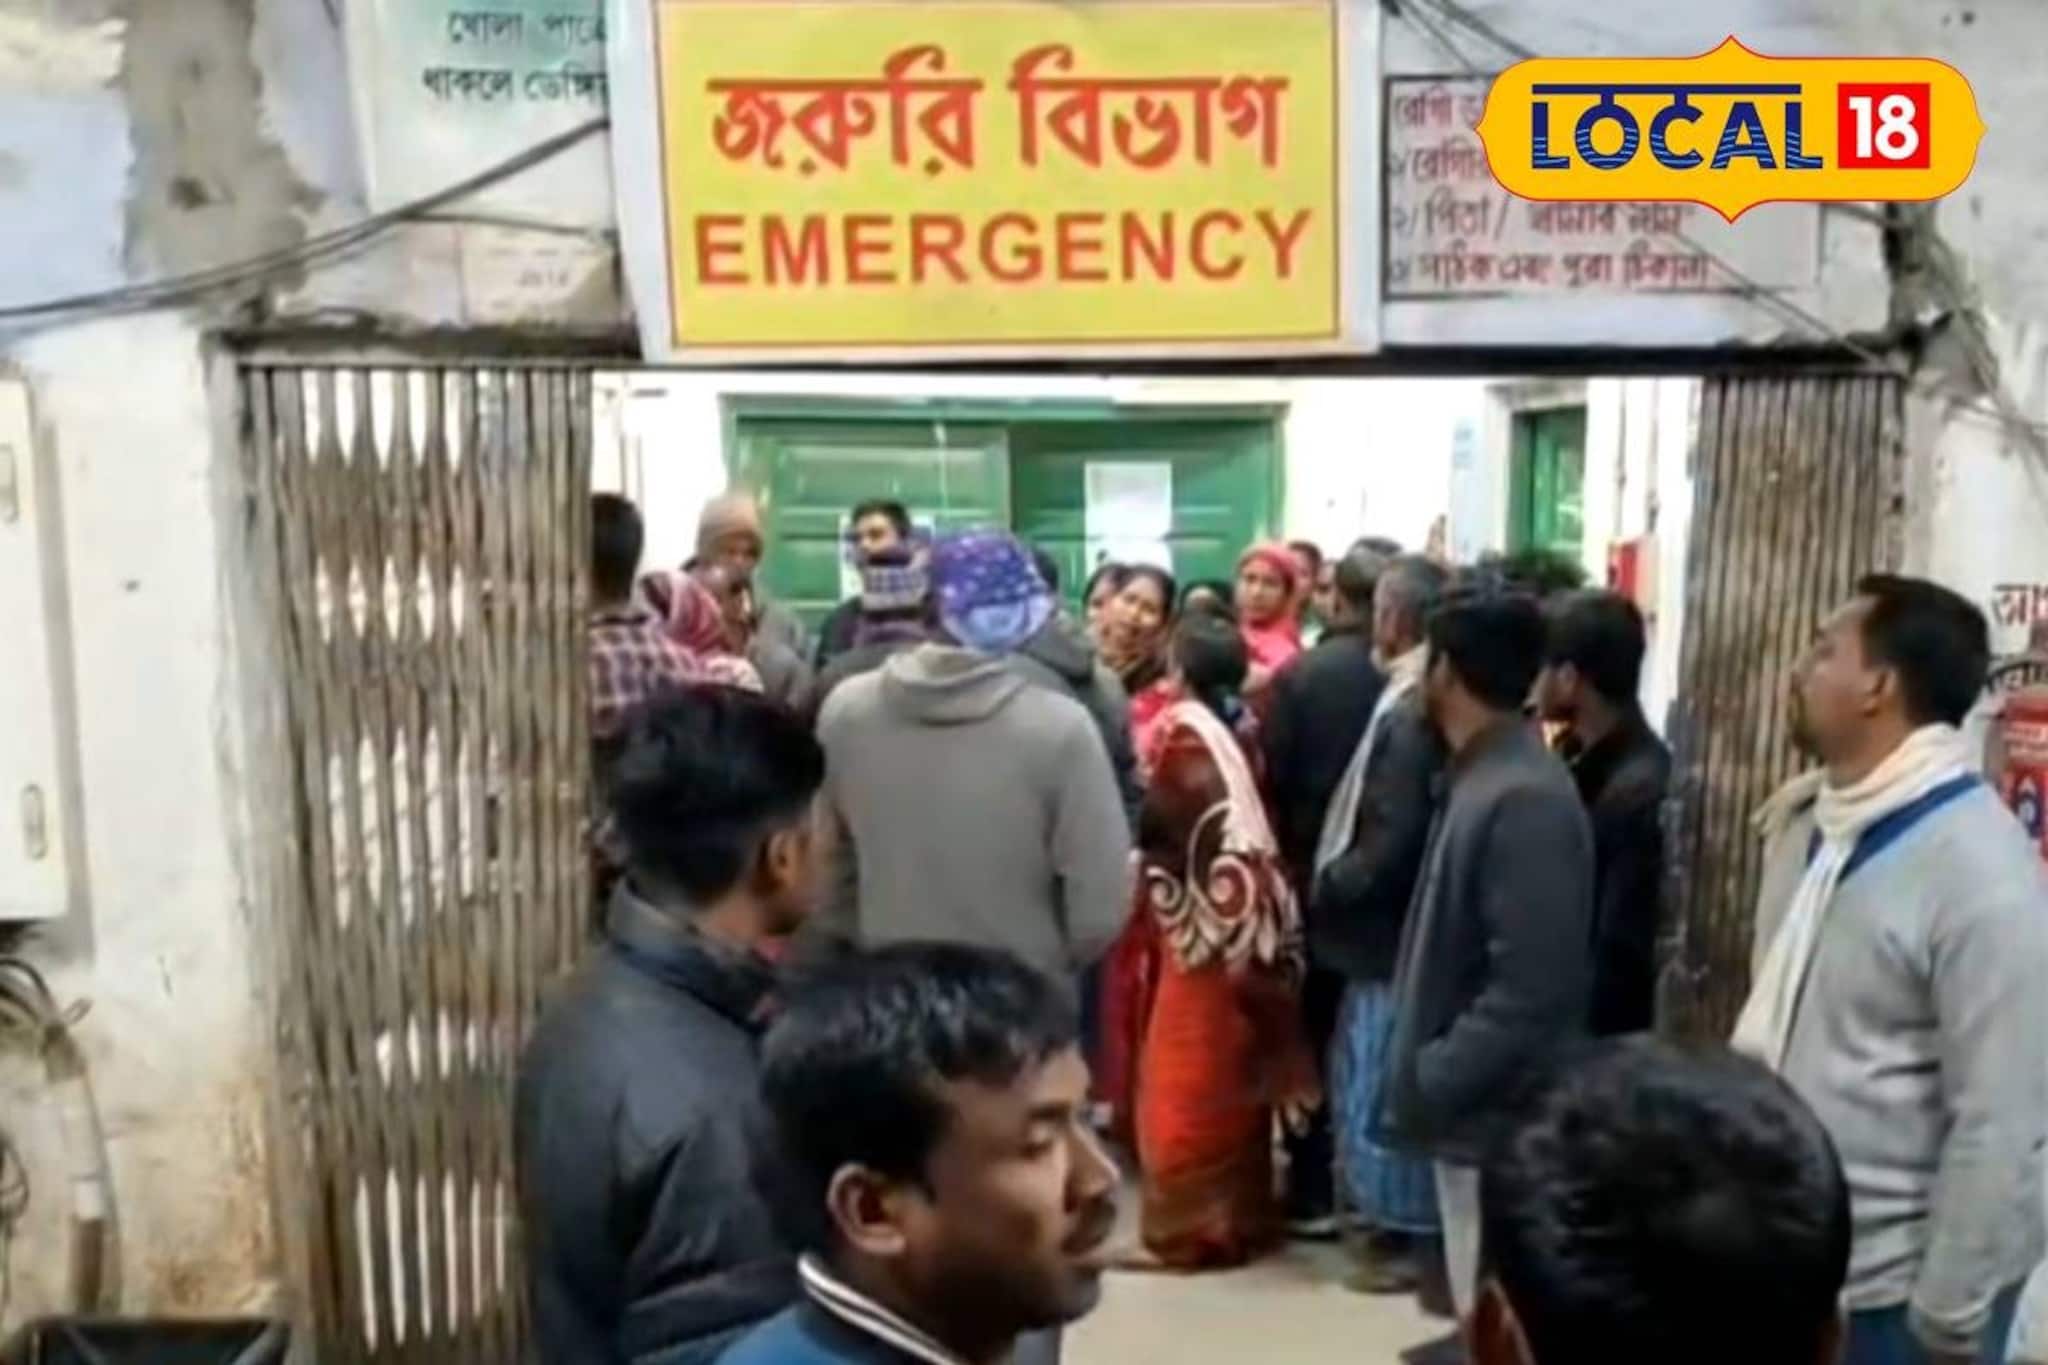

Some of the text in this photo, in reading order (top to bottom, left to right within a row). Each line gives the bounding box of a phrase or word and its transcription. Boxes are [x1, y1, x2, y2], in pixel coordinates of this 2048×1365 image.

[706, 43, 1289, 177] জরুরি বিভাগ
[695, 208, 1312, 286] EMERGENCY
